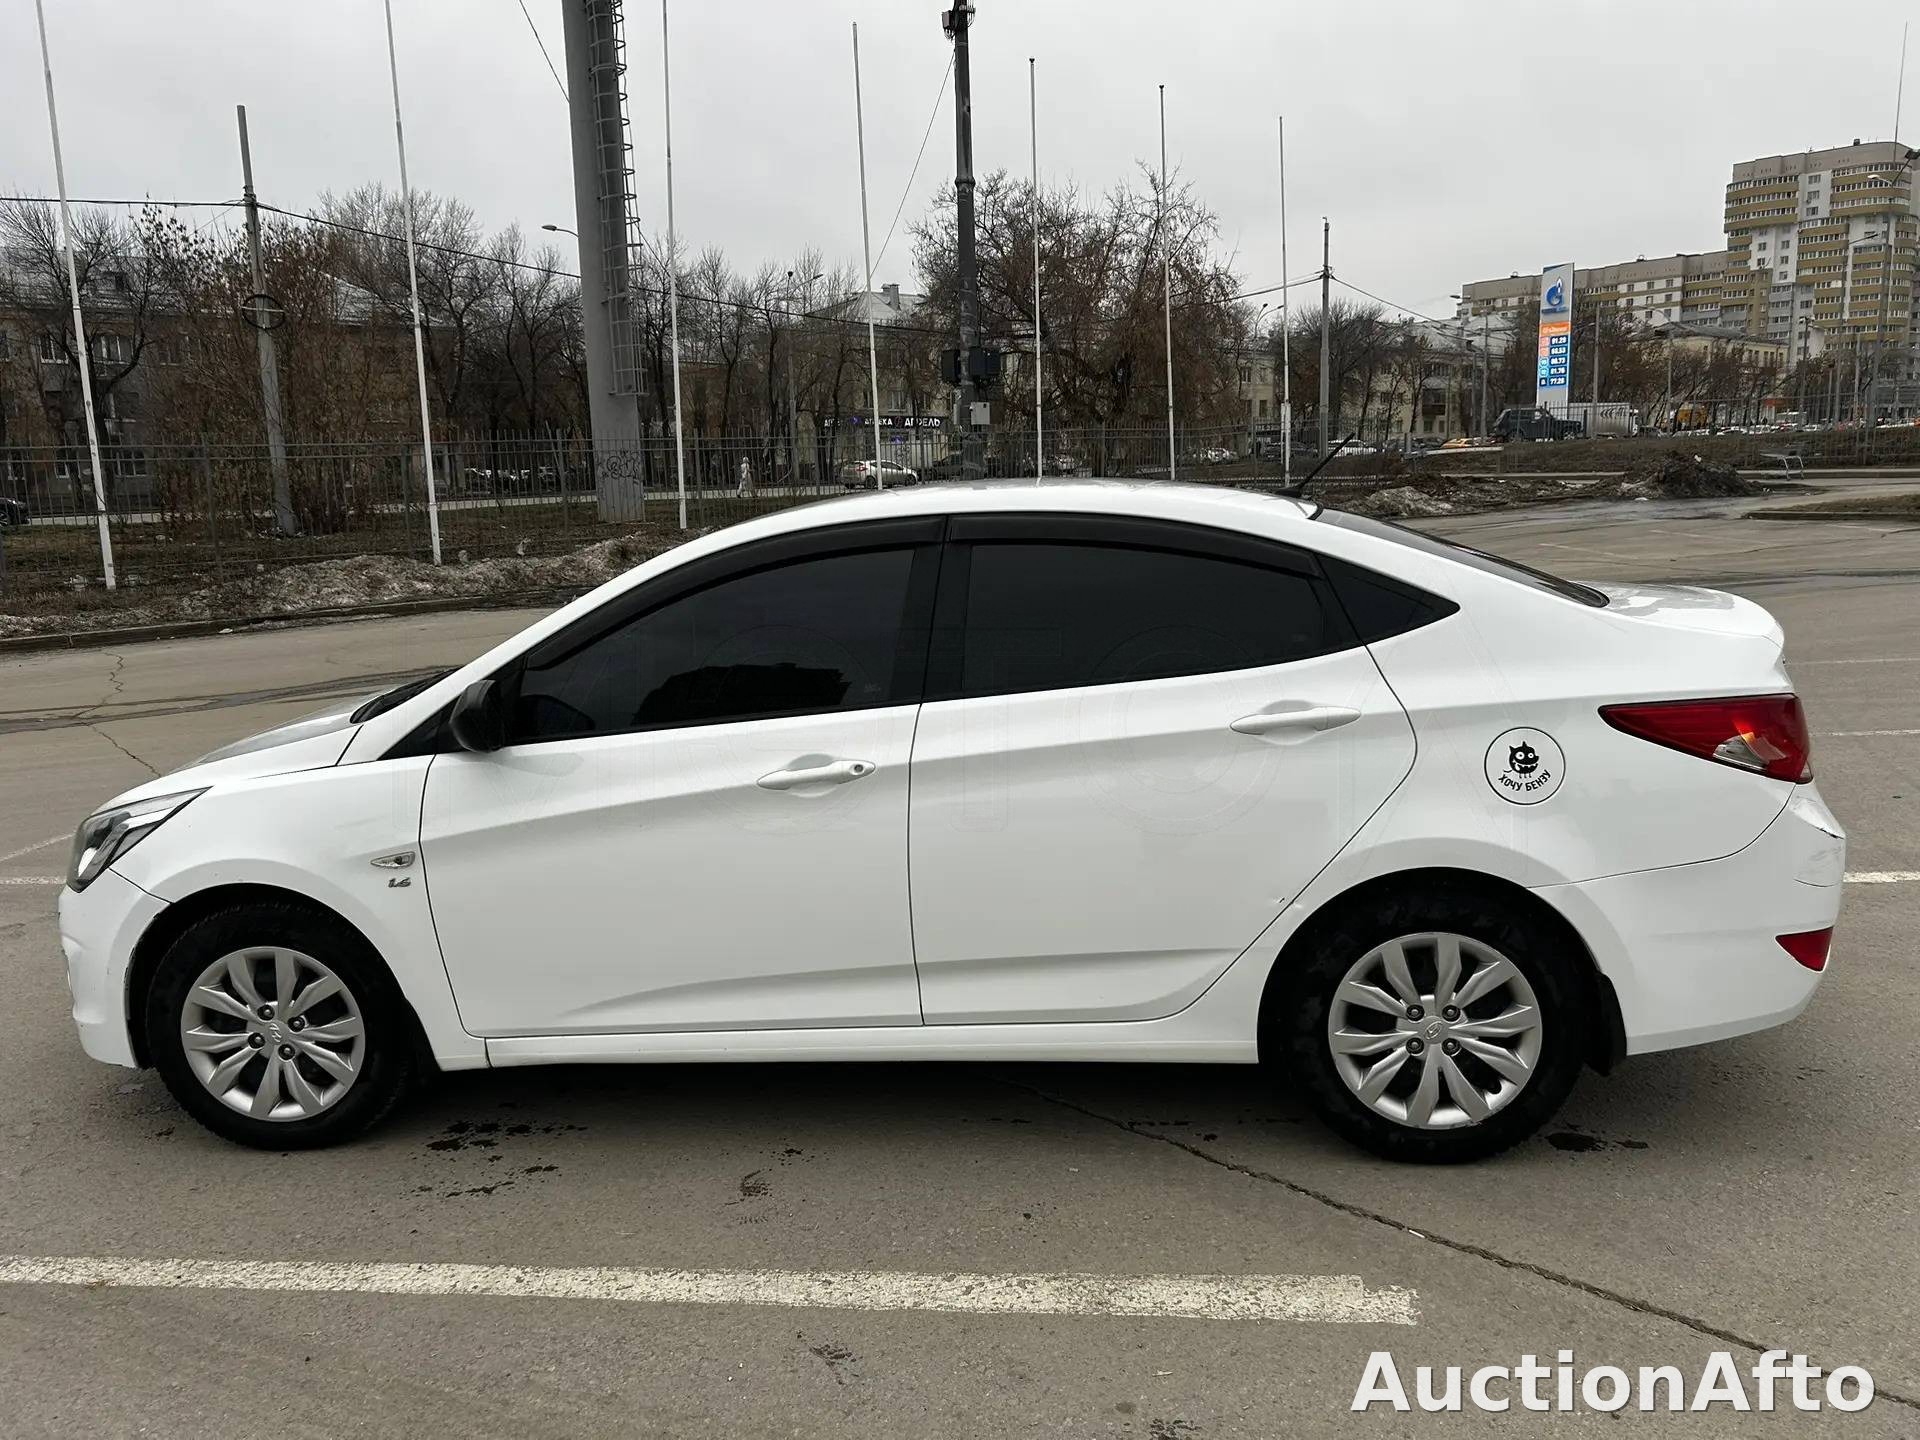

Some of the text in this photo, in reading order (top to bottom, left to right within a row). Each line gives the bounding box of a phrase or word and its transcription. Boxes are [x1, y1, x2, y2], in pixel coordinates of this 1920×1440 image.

[864, 418, 893, 427] АПЕКА
[1498, 769, 1551, 792] ХОЧУ БЕНЗУ
